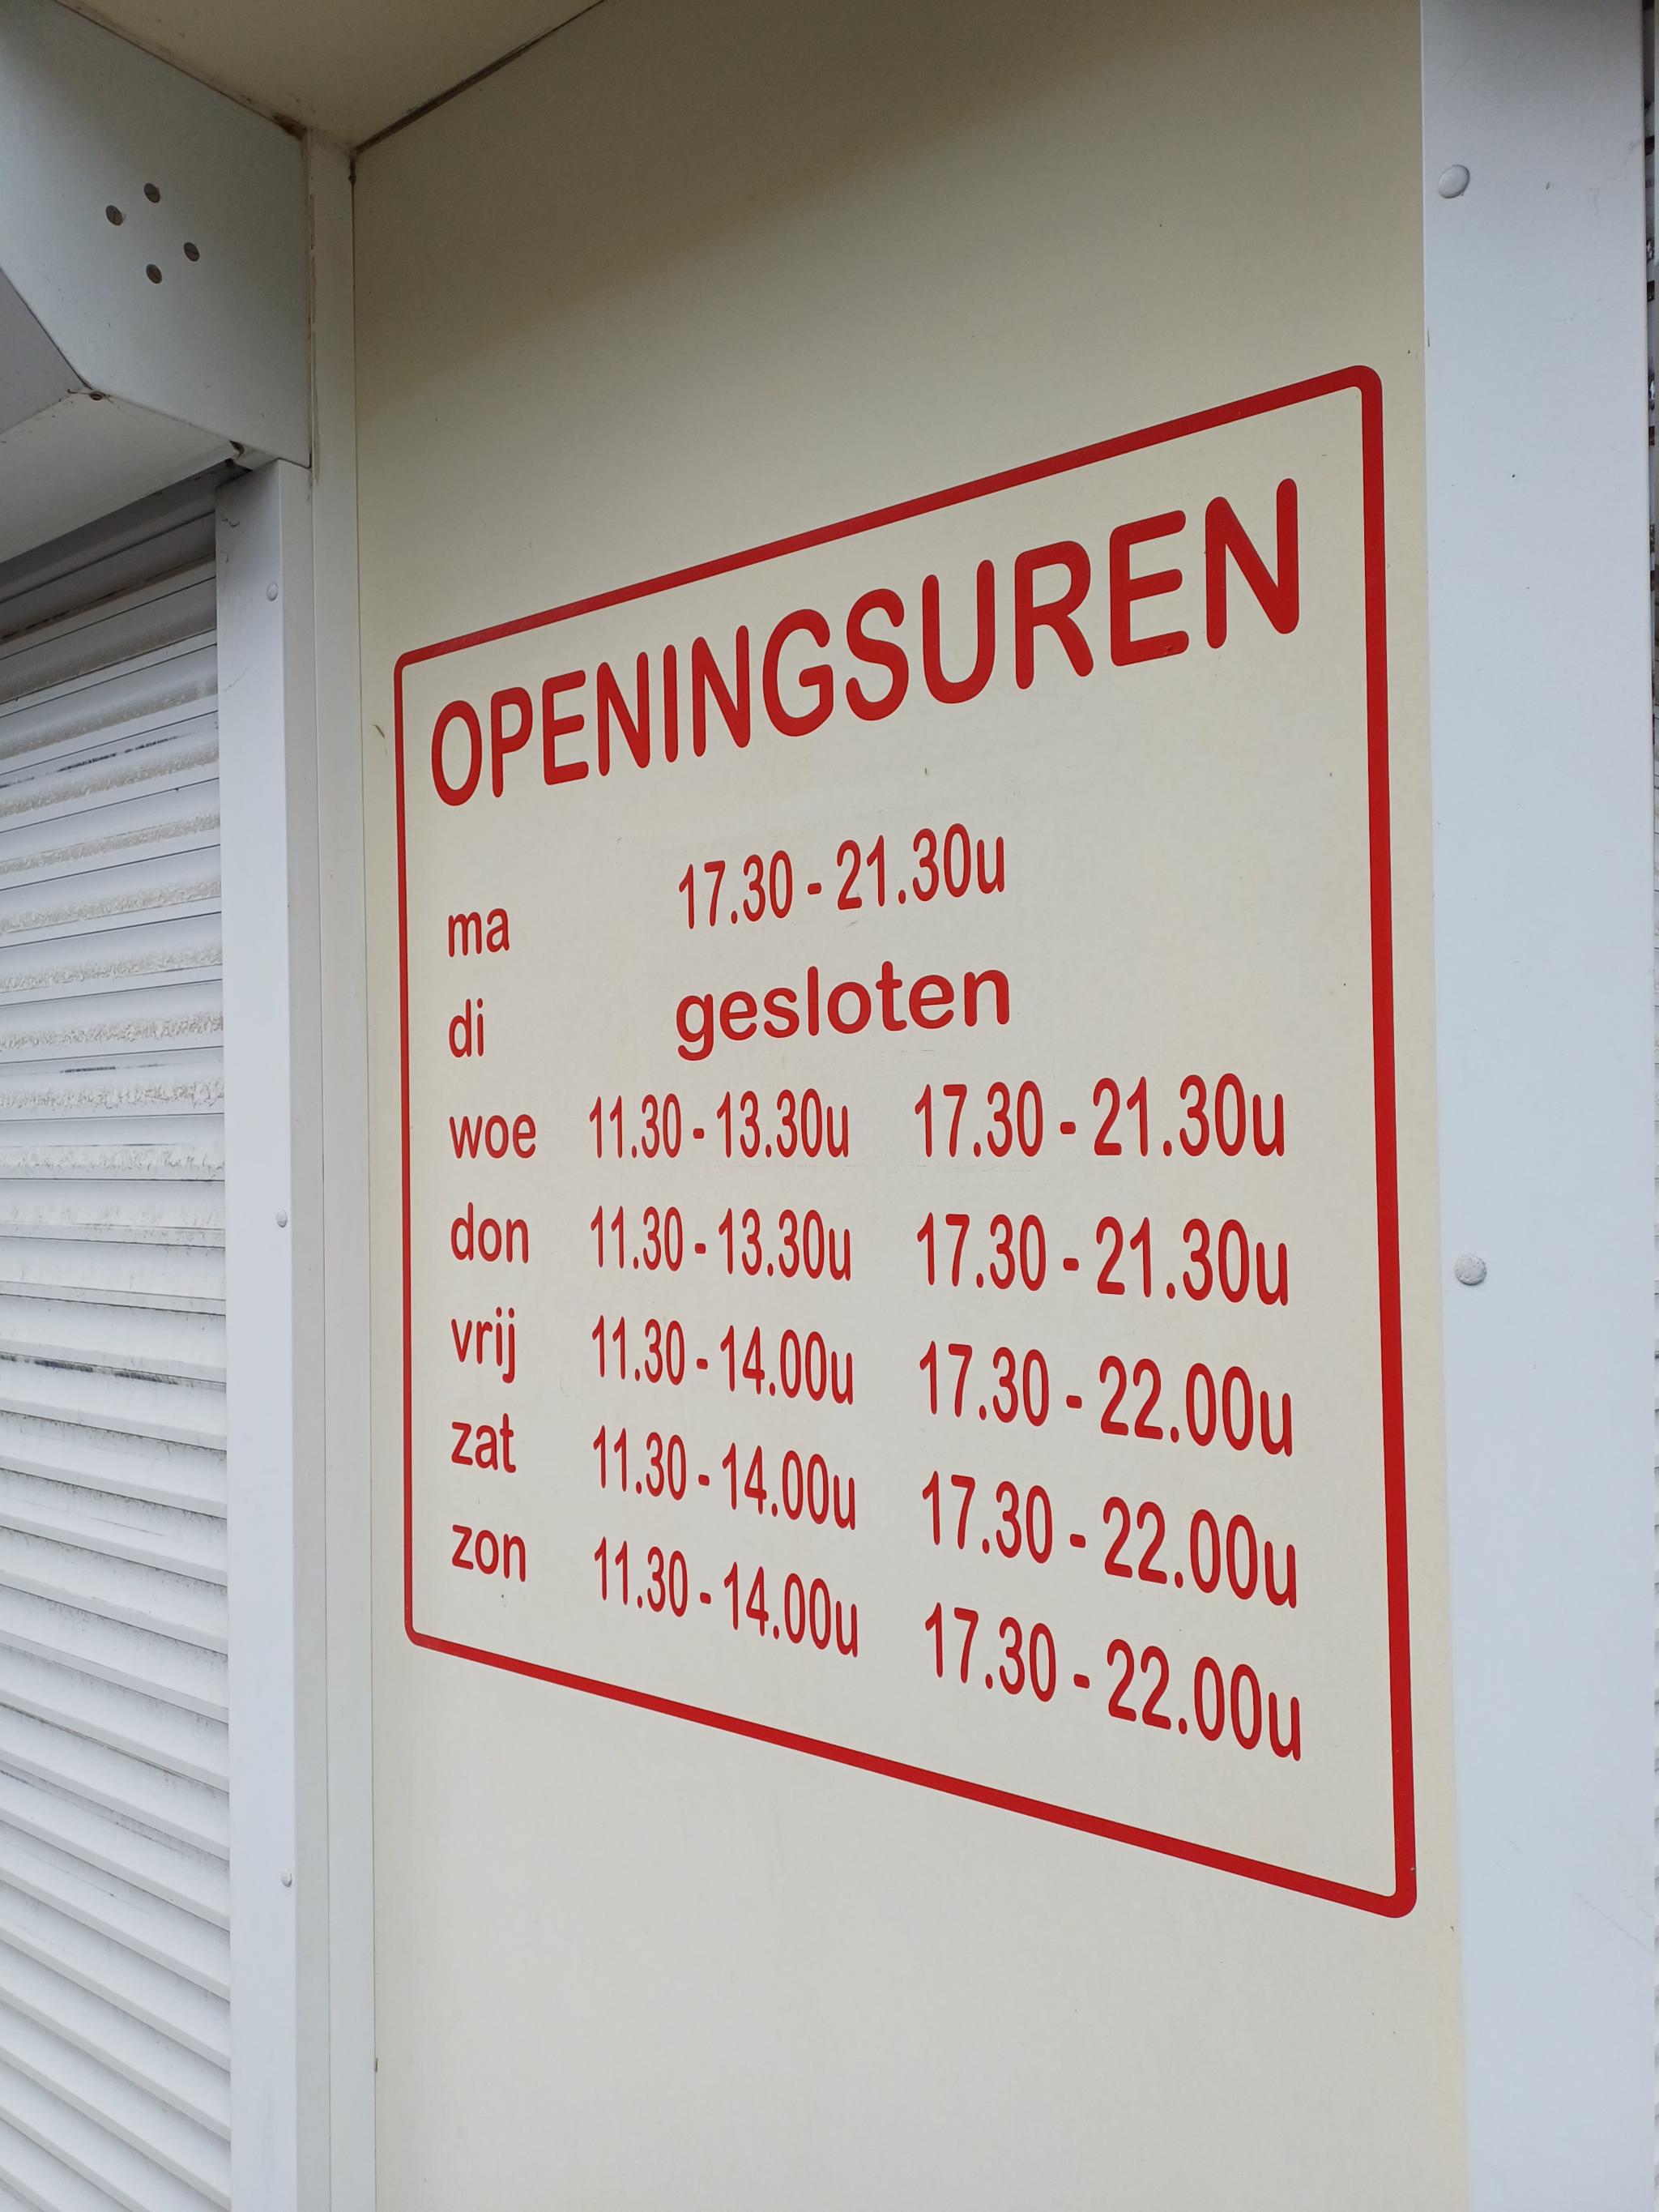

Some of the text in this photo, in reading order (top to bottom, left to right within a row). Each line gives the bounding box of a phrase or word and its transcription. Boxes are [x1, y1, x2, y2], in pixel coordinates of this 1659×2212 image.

[431, 478, 1300, 808] OPENINGSUREN
[447, 907, 510, 958] ma
[678, 849, 794, 930] 17.30
[836, 822, 1005, 912] 21.30u
[448, 960, 1010, 1062] di gesloten
[449, 1114, 537, 1159] woe
[589, 1093, 682, 1159] 11.30
[716, 1088, 850, 1159] 13.30u
[914, 1080, 1043, 1159] 17.30
[1092, 1072, 1285, 1158] 21.30u
[450, 1202, 530, 1263] don
[590, 1205, 684, 1272] 11.30
[718, 1207, 852, 1282] 13.30u
[916, 1212, 1047, 1292] 17.30
[1095, 1215, 1289, 1307] 21.30u
[450, 1306, 516, 1385] vrij
[591, 1315, 685, 1386] 11.30
[719, 1325, 854, 1405] 14.00u
[919, 1341, 1050, 1427] 17.30
[1098, 1355, 1293, 1458] 22.00u
[450, 1412, 517, 1474] zat
[592, 1425, 687, 1501] 11.30
[722, 1442, 856, 1531] 14.00u
[921, 1471, 1053, 1565] 17.30
[1102, 1496, 1297, 1608] 22.00u
[451, 1523, 527, 1582] zon
[593, 1537, 689, 1618] 11.30
[723, 1561, 859, 1658] 14.00u
[924, 1603, 1057, 1703] 17.30
[1106, 1638, 1302, 1762] 22.00u
